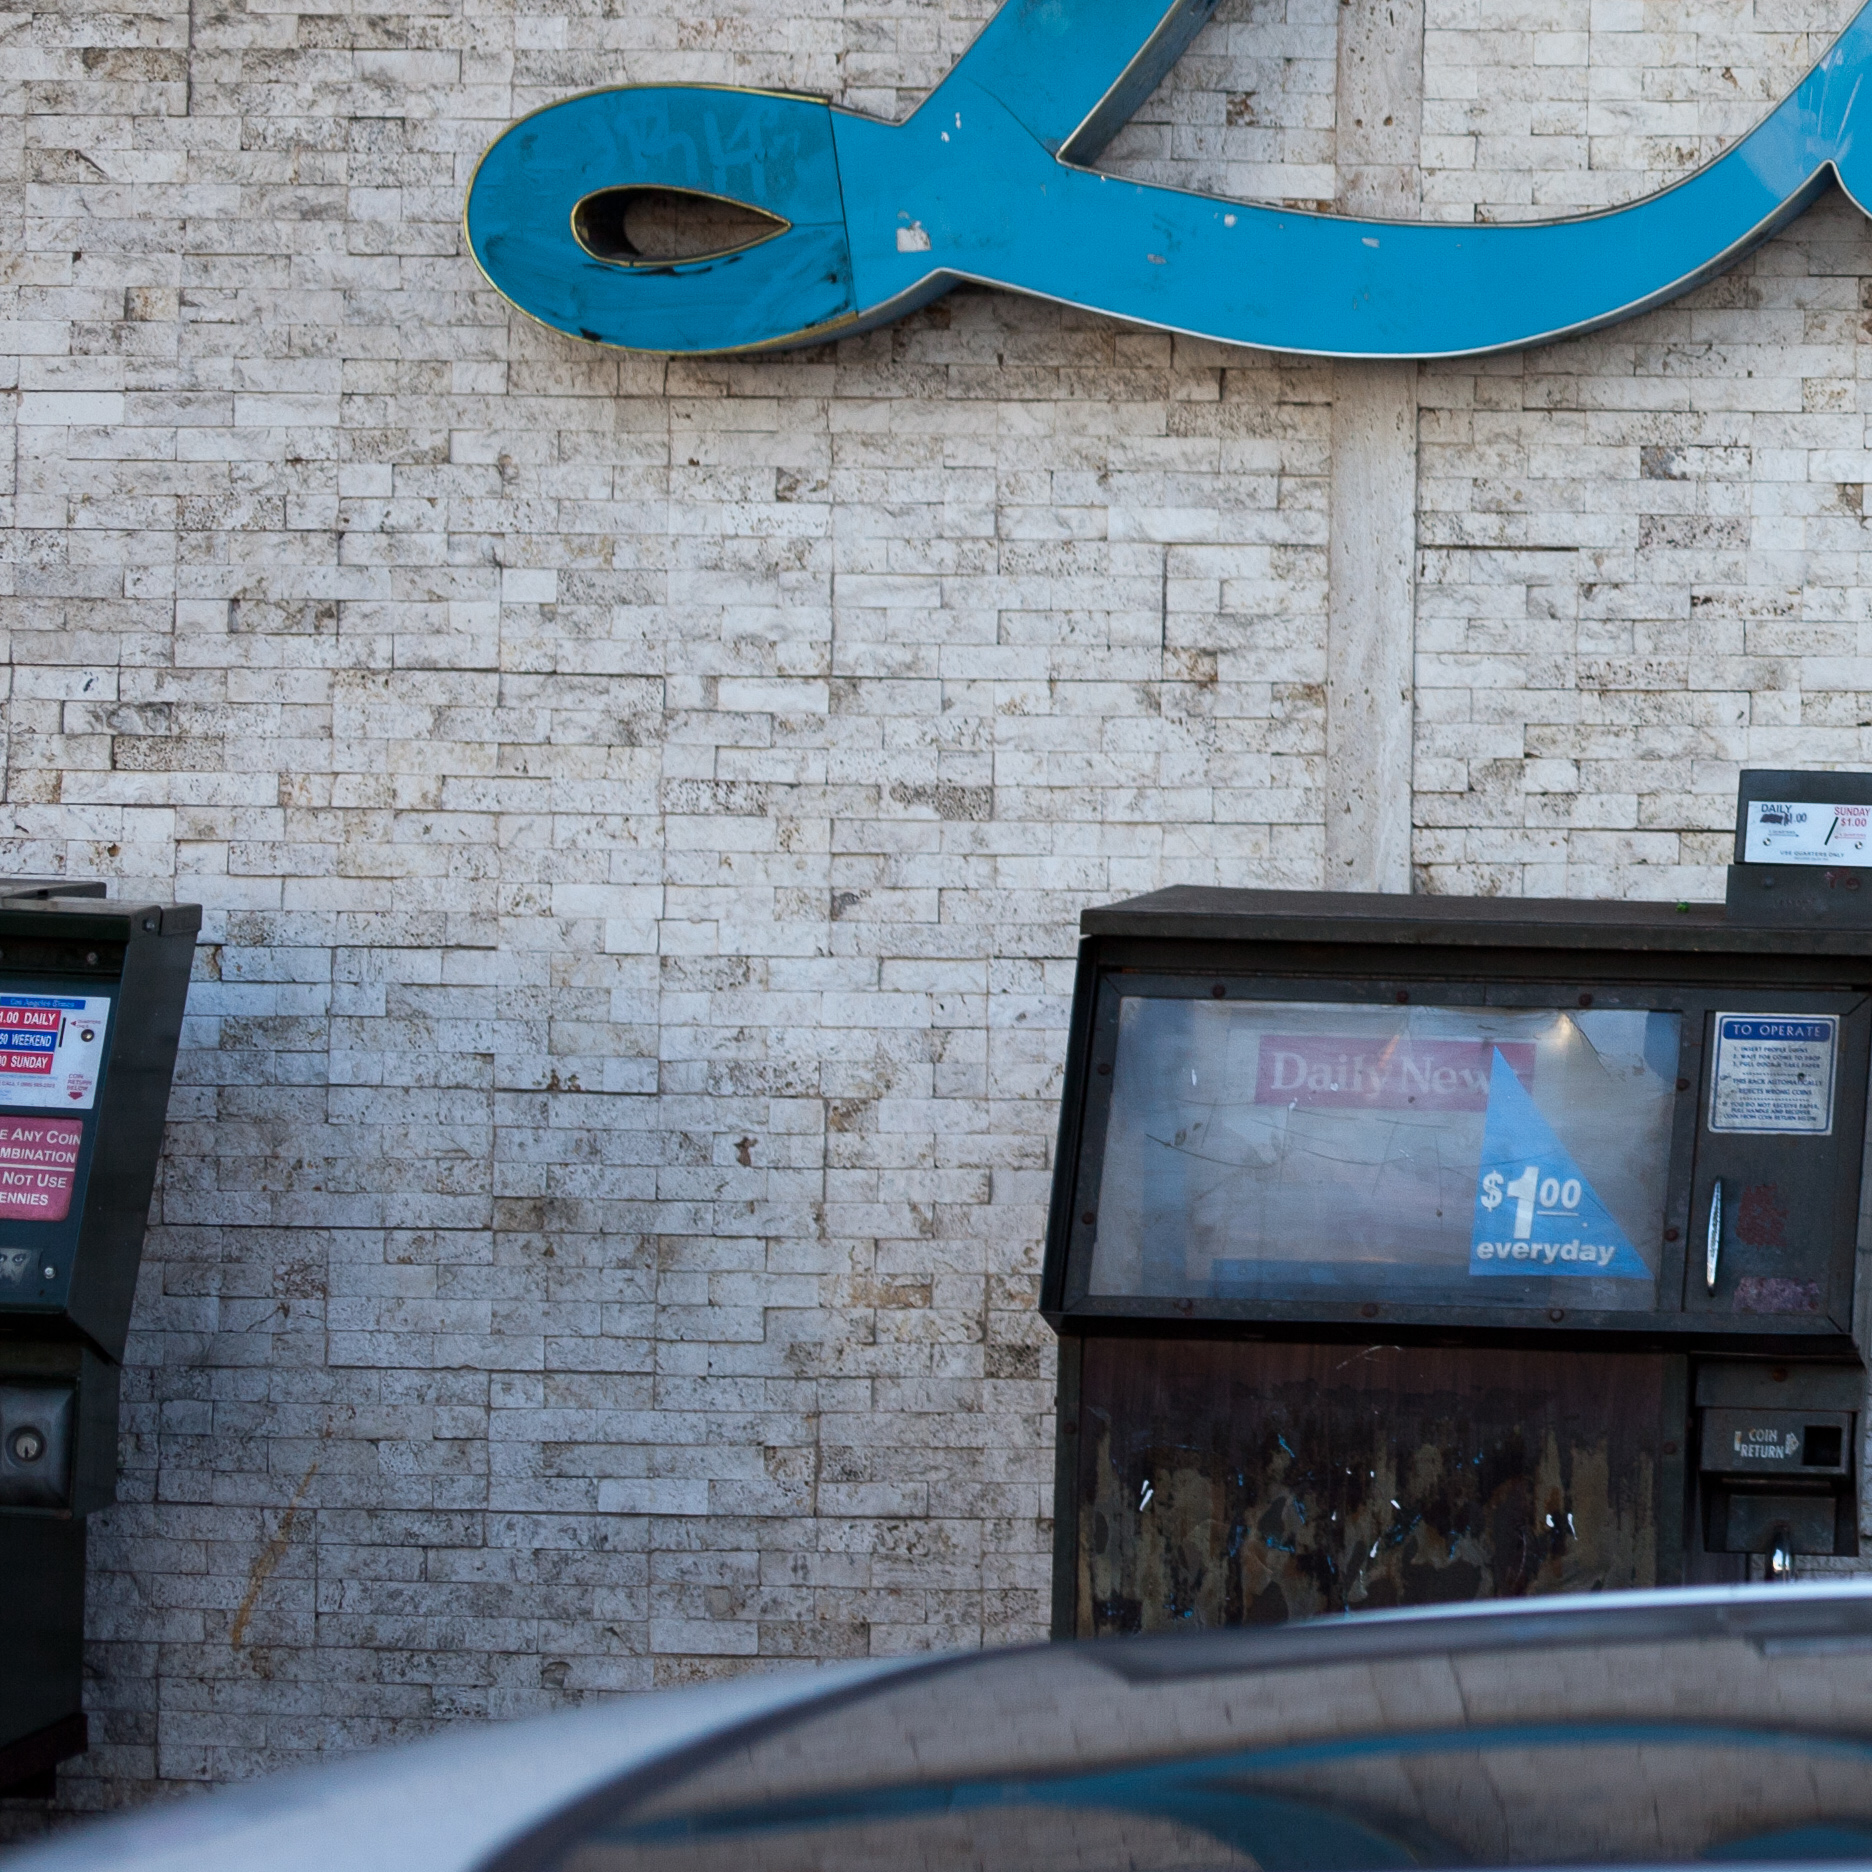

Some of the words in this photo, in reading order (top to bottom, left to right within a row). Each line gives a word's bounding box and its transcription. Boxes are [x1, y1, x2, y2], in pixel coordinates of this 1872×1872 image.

[1760, 803, 1792, 813] DAILY
[1834, 806, 1871, 817] SUNDAY
[1840, 818, 1867, 828] $1.00
[23, 1012, 57, 1026] DAILY
[1733, 1024, 1752, 1036] TO
[1759, 1025, 1821, 1037] OPERATE
[12, 1033, 52, 1047] WEEKEND
[10, 1055, 49, 1069] SUNDAY
[1270, 1050, 1388, 1100] Daily
[1399, 1054, 1518, 1096] New
[11, 1127, 44, 1143] ANY
[46, 1130, 82, 1146] COIN
[0, 1146, 76, 1163] MBINATION
[2, 1170, 34, 1186] NOT
[36, 1173, 68, 1188] USE
[1476, 1239, 1616, 1267] everyday
[1748, 1428, 1778, 1443] COIN
[1741, 1443, 1785, 1459] RETURN
